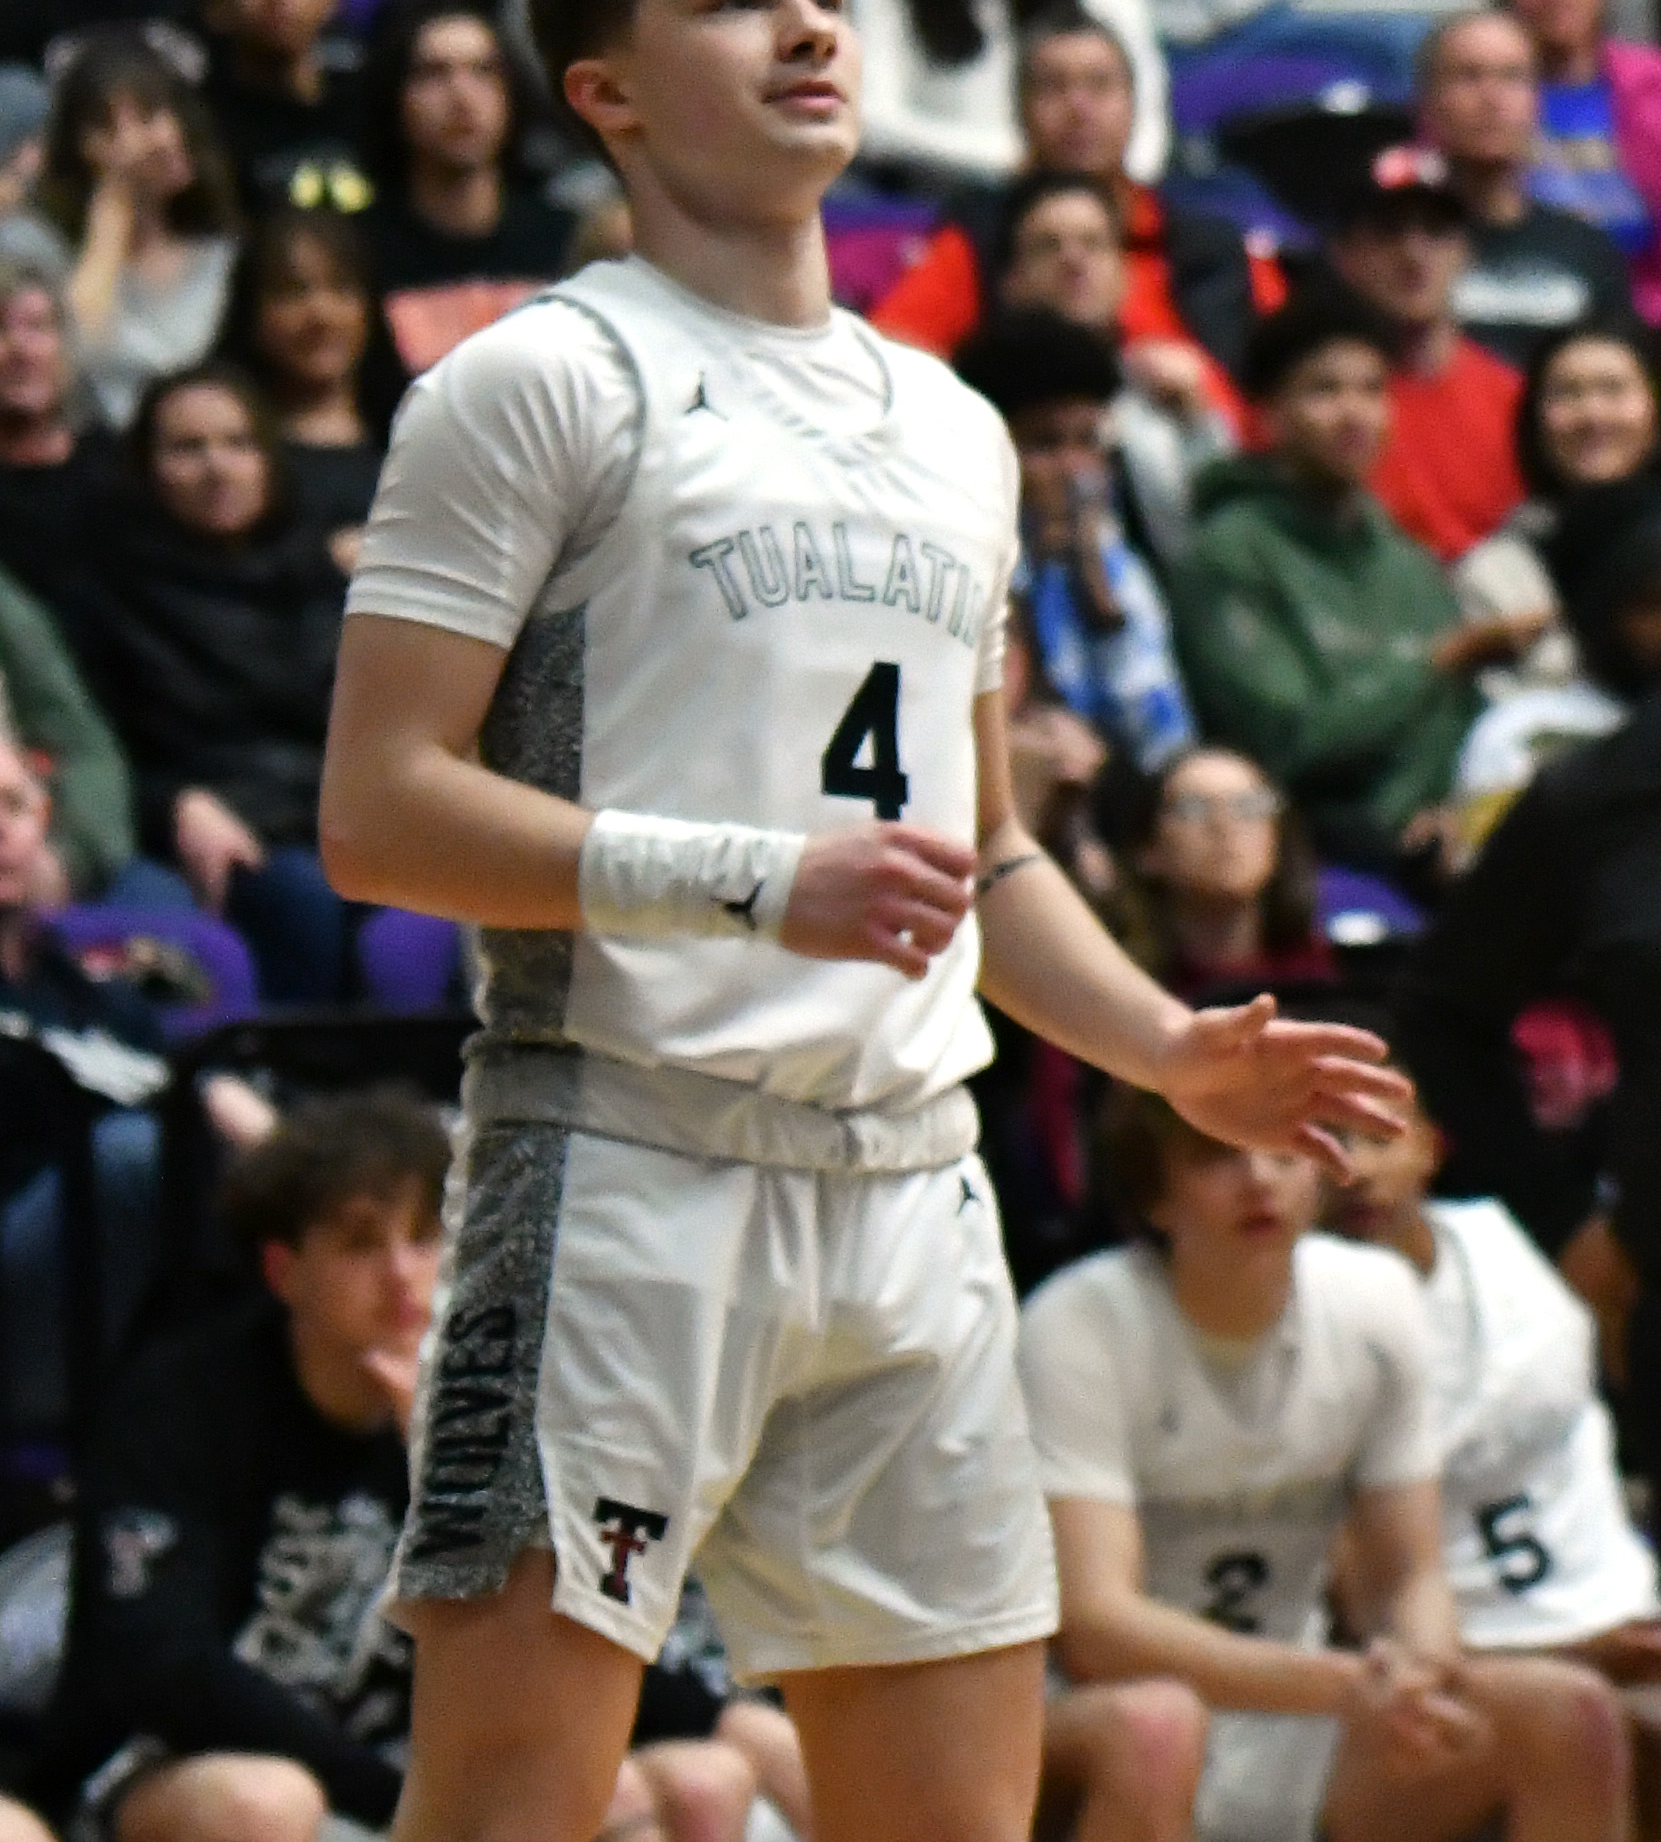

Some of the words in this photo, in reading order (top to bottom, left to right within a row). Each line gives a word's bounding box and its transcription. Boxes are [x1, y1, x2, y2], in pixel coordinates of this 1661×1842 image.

[821, 661, 909, 820] 4
[1202, 1551, 1271, 1634] 2
[1474, 1492, 1551, 1595] 5
